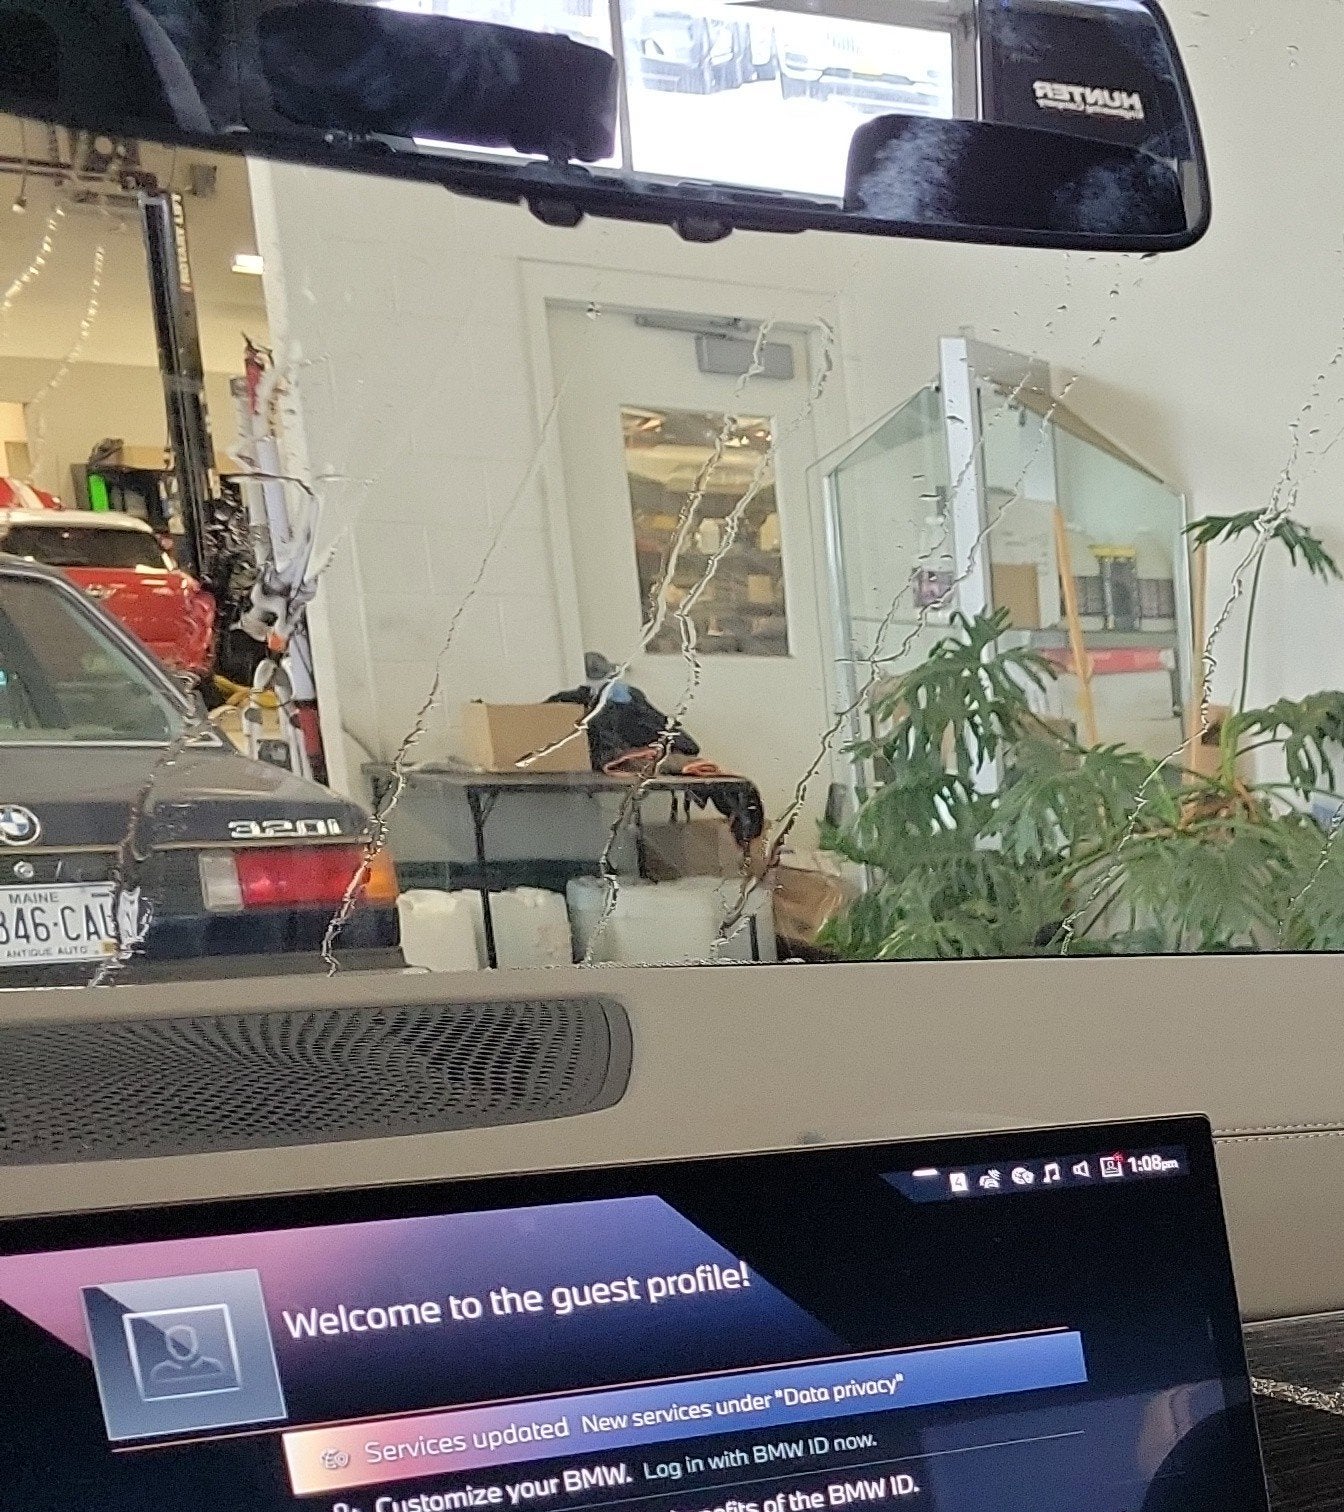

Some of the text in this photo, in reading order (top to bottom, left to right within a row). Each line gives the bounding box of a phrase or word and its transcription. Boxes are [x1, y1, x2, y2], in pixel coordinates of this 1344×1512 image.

[8, 891, 59, 904] MAINE
[6, 945, 88, 958] ANTIQUE AUTO
[1127, 1154, 1179, 1174] 1:08pm
[282, 1260, 751, 1339] Welcome to the guest profile!
[364, 1373, 905, 1463] Services updated New services under "Data privacy"
[505, 1476, 560, 1505] your
[563, 1462, 633, 1492] BMW.
[643, 1461, 683, 1480] Log
[685, 1456, 704, 1473] in
[707, 1450, 749, 1470] with
[753, 1440, 804, 1463] BMW
[808, 1437, 830, 1456] ID
[834, 1432, 878, 1451] now.
[788, 1491, 825, 1511] the
[828, 1477, 886, 1505] BMW
[890, 1473, 920, 1495] ID.
